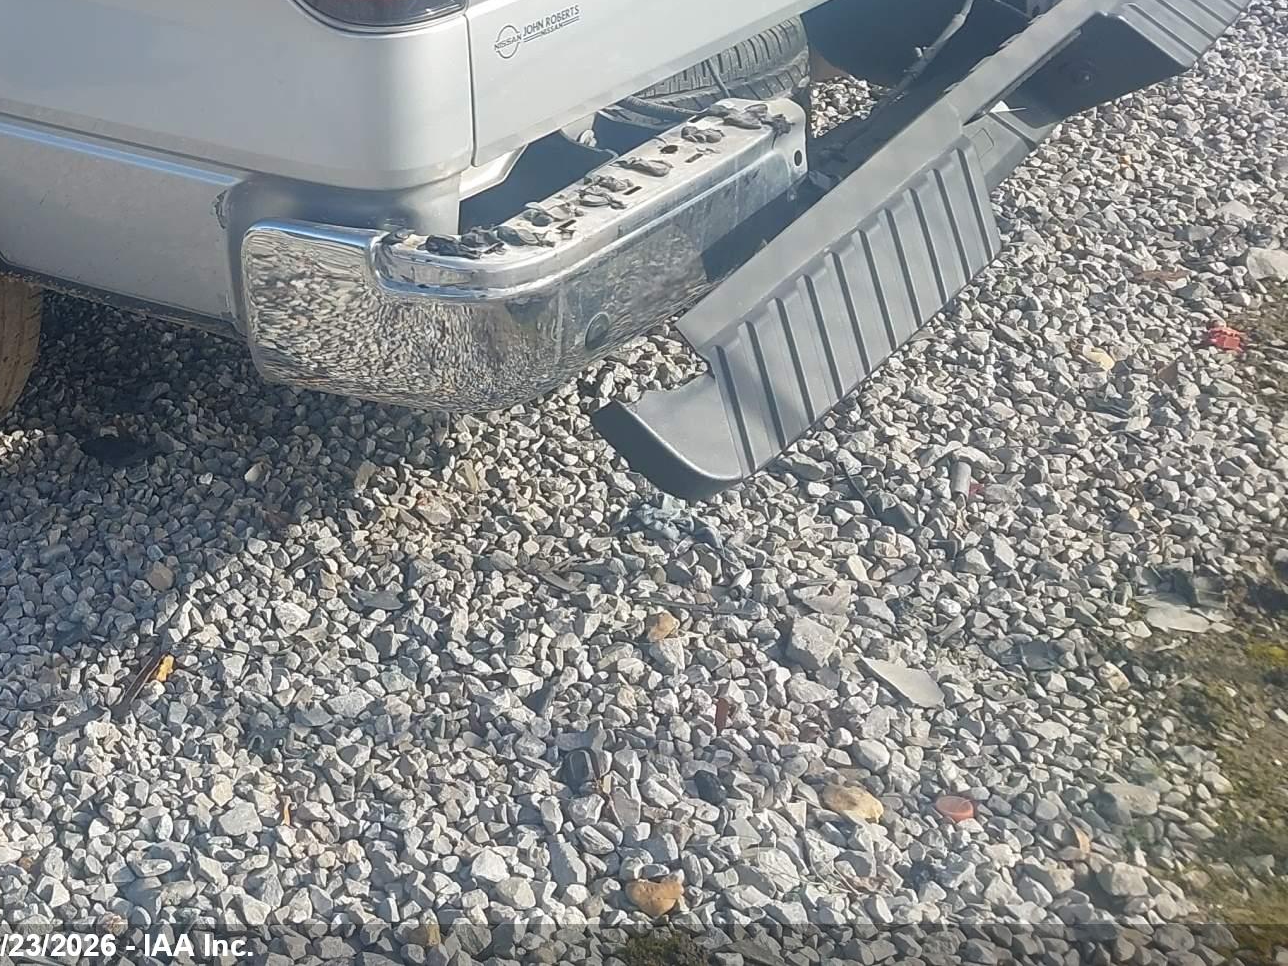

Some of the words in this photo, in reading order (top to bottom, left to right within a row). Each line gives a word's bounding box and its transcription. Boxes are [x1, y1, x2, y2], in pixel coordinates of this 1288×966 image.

[523, 19, 544, 37] JOHN
[545, 5, 580, 27] ROBERTS
[540, 22, 563, 36] NISSAN
[494, 33, 522, 51] NISSAN
